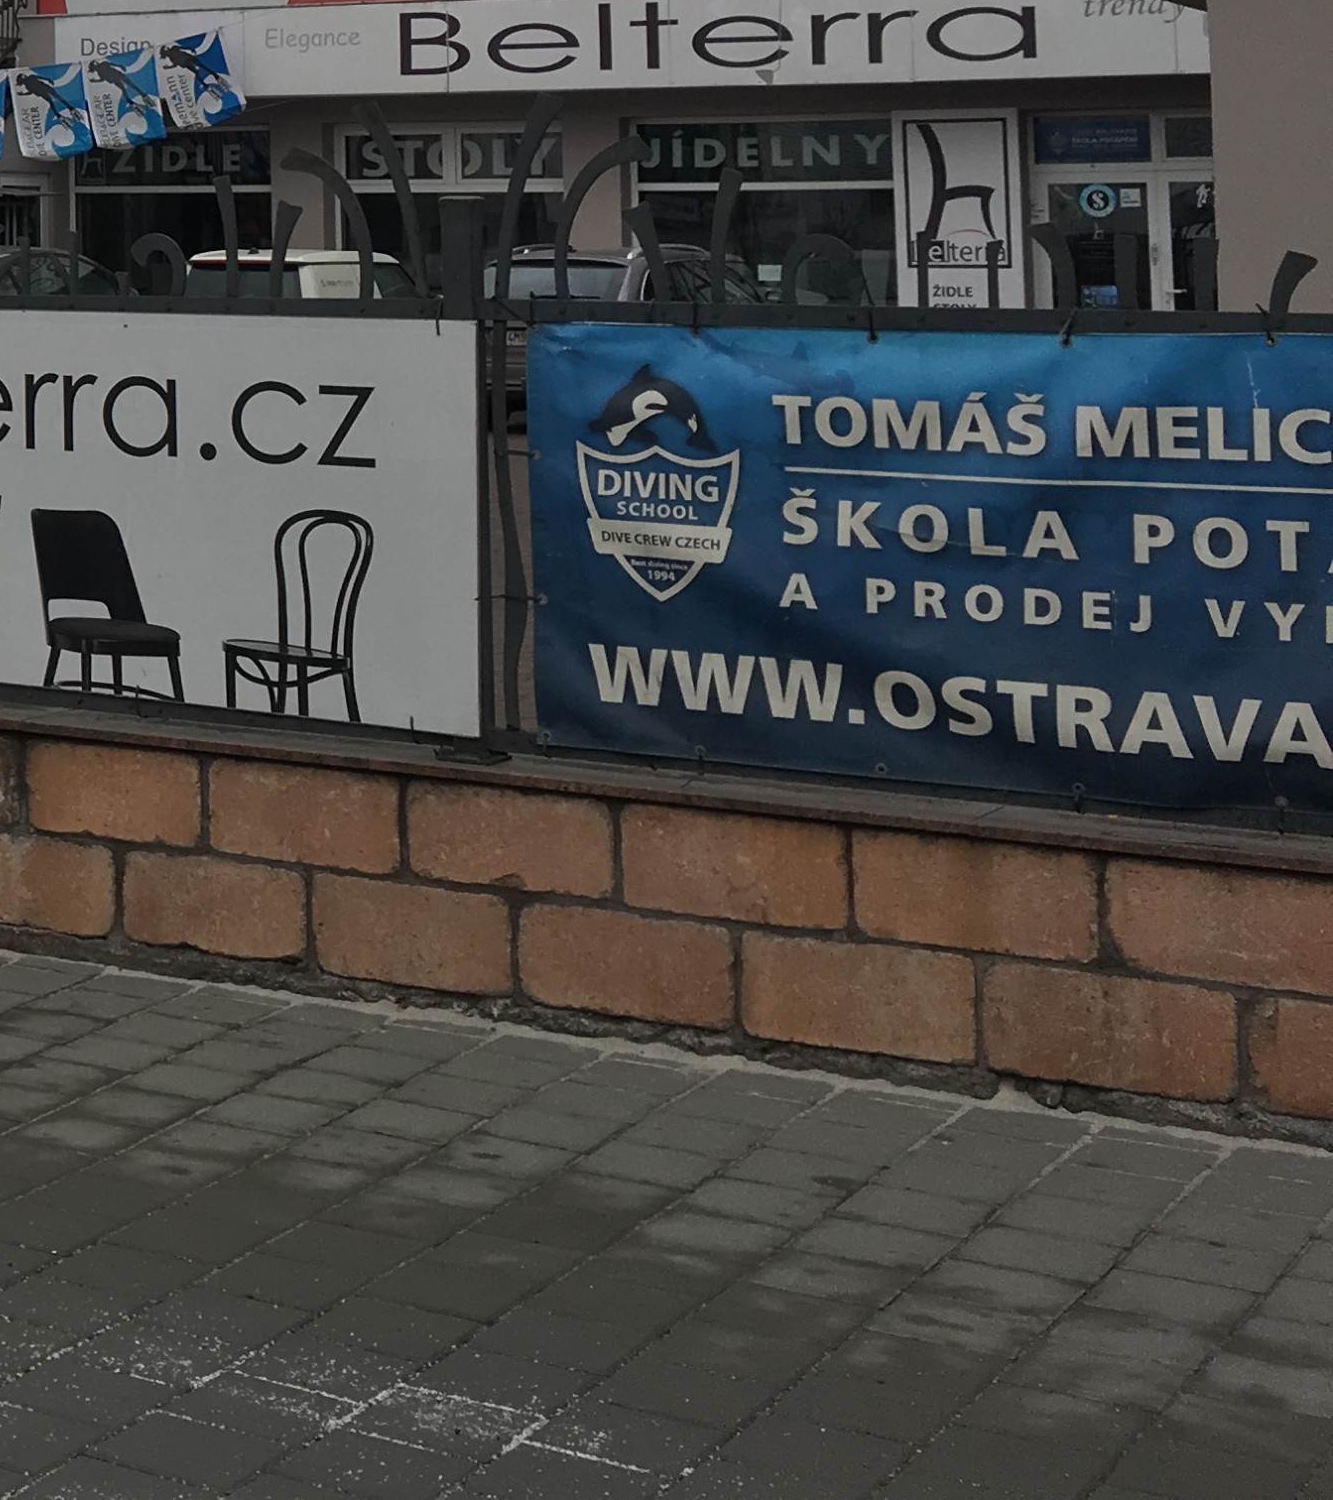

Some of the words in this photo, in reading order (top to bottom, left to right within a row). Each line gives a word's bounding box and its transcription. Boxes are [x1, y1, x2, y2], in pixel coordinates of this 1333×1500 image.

[265, 28, 361, 52] Elegance
[398, 2, 1037, 76] Belterra
[30, 105, 42, 140] CENTER
[103, 93, 117, 127] CENTER
[641, 129, 889, 169] JÍDELNY
[933, 284, 973, 298] ŽIDLE
[771, 391, 1047, 457] TOMÁŠ
[597, 469, 719, 503] DIVING
[616, 500, 698, 521] SCHOOL
[601, 530, 632, 544] DIVE
[634, 533, 672, 547] CREW
[675, 536, 721, 550] CZECH
[782, 487, 1079, 561] ŠKOLA
[1133, 513, 1333, 575] POT
[647, 570, 675, 581] 1994
[780, 573, 817, 610] A
[866, 577, 1154, 634] PRODEJ
